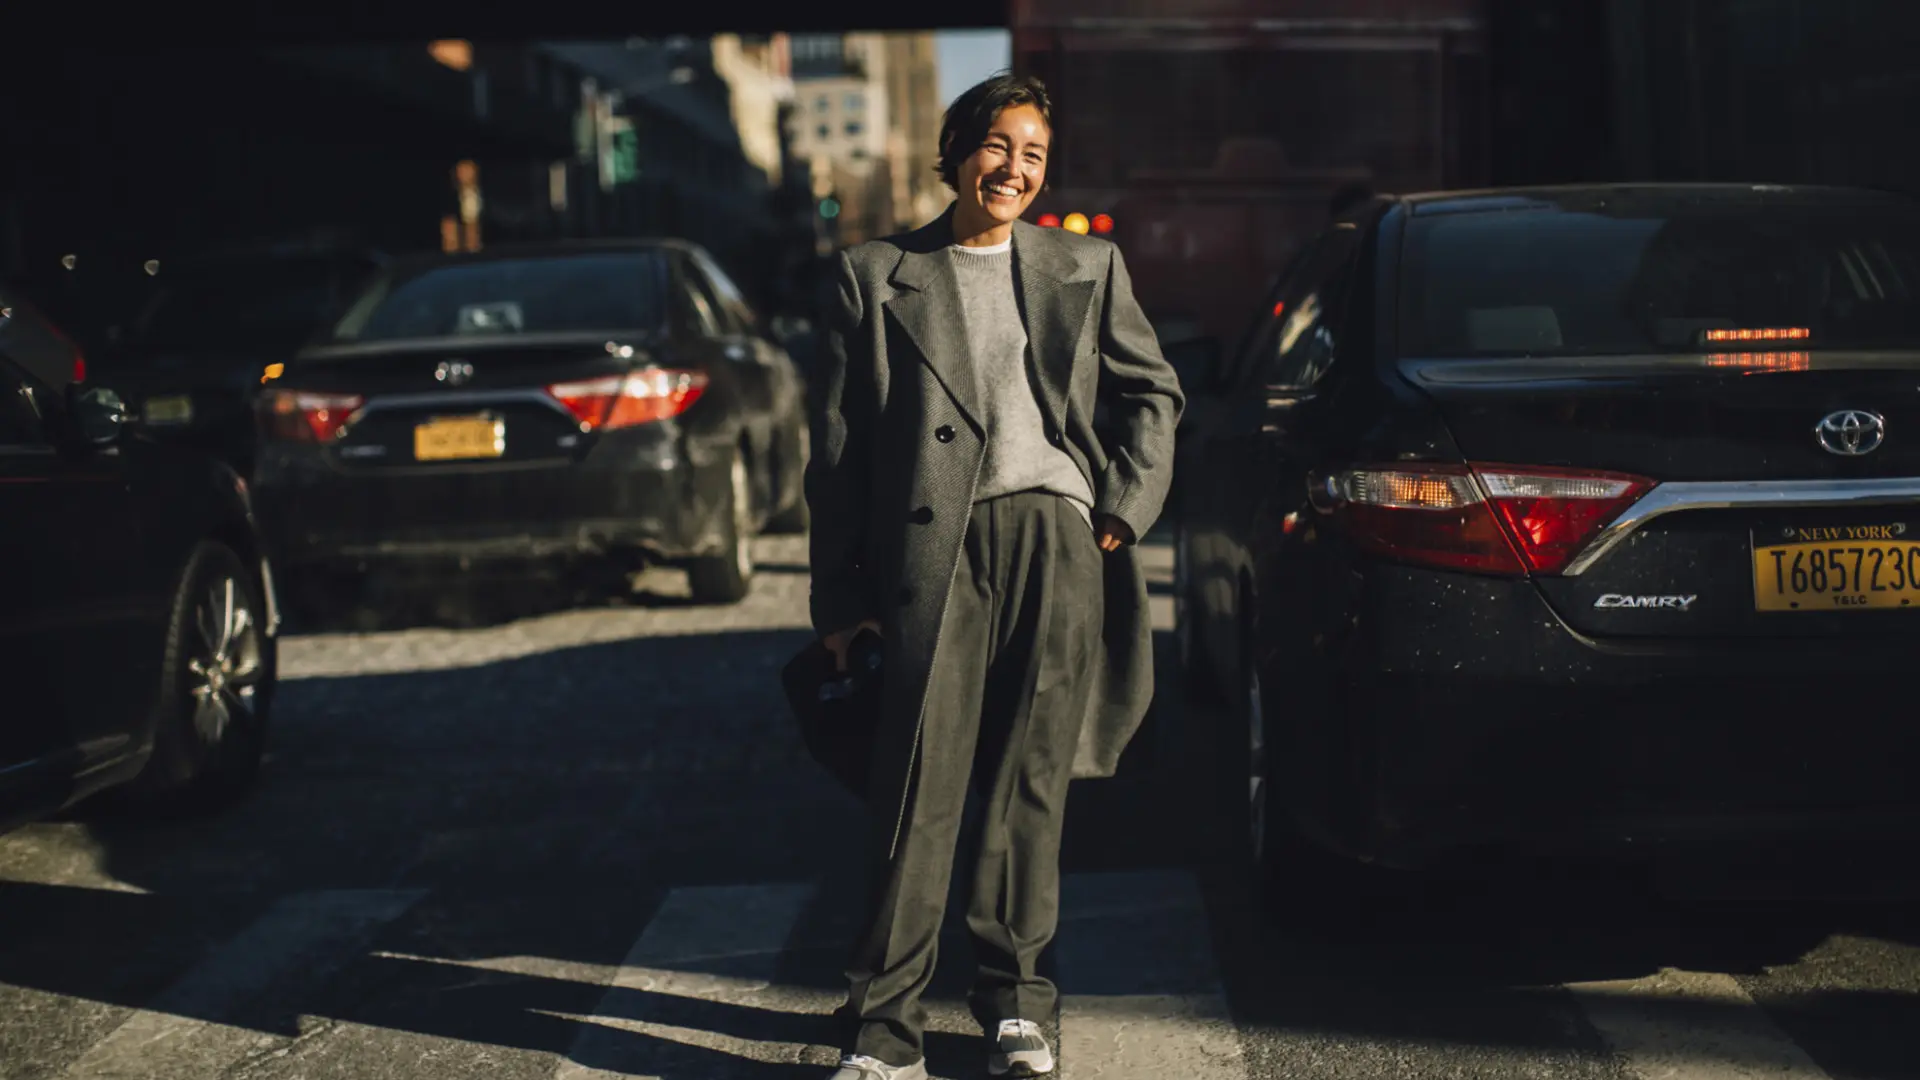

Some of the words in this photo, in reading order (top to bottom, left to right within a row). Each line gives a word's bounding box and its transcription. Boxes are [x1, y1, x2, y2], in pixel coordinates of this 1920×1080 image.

[1799, 527, 1841, 541] NEW
[1845, 524, 1893, 540] YORK
[1593, 593, 1698, 611] CAMRY
